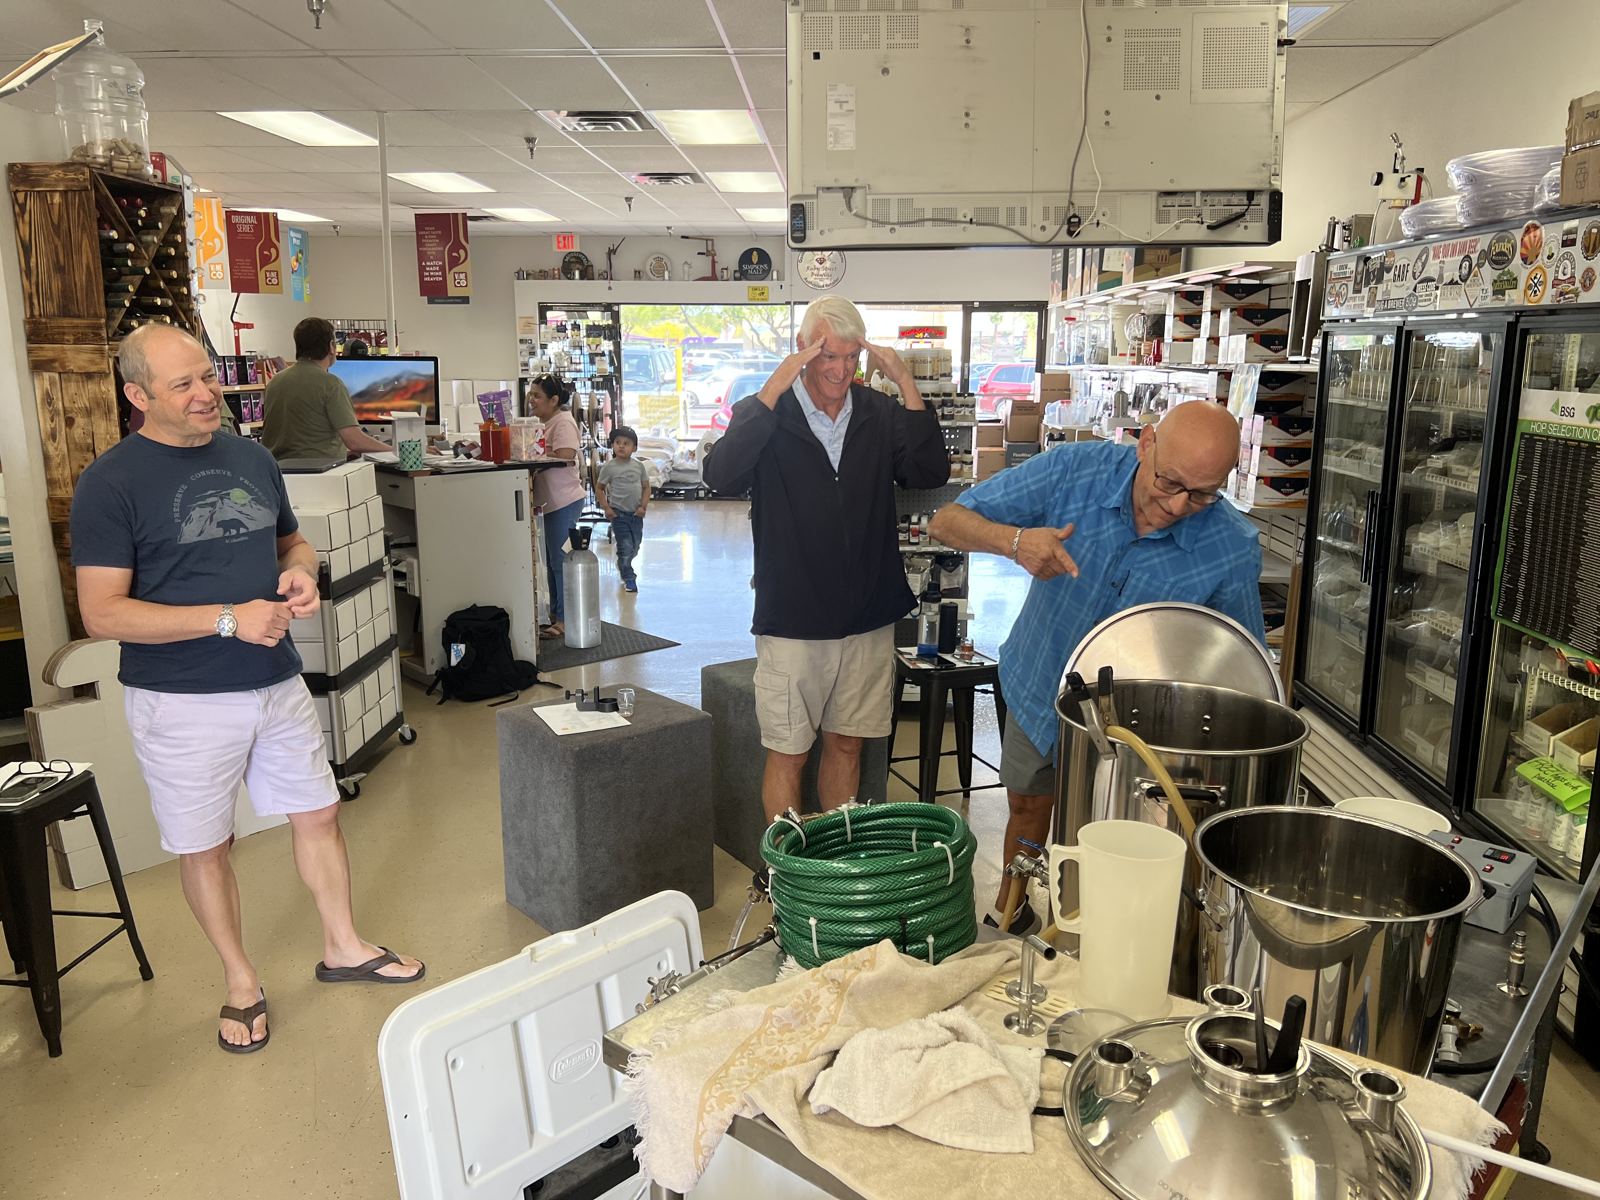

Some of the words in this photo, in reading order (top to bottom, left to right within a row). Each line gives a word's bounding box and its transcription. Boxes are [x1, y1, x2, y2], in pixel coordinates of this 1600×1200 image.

[231, 215, 258, 224] ORIGINAL
[236, 224, 254, 233] SERIES
[556, 234, 575, 250] EXIT
[210, 271, 223, 279] CO
[1393, 263, 1410, 283] GABF
[266, 277, 278, 285] CO
[1560, 406, 1576, 418] BSG
[1530, 422, 1547, 433] HOP
[1548, 424, 1591, 440] SELECTION
[190, 469, 232, 481] CONSERVE
[173, 484, 188, 523] PRESERVE
[558, 1047, 593, 1076] Coleman
